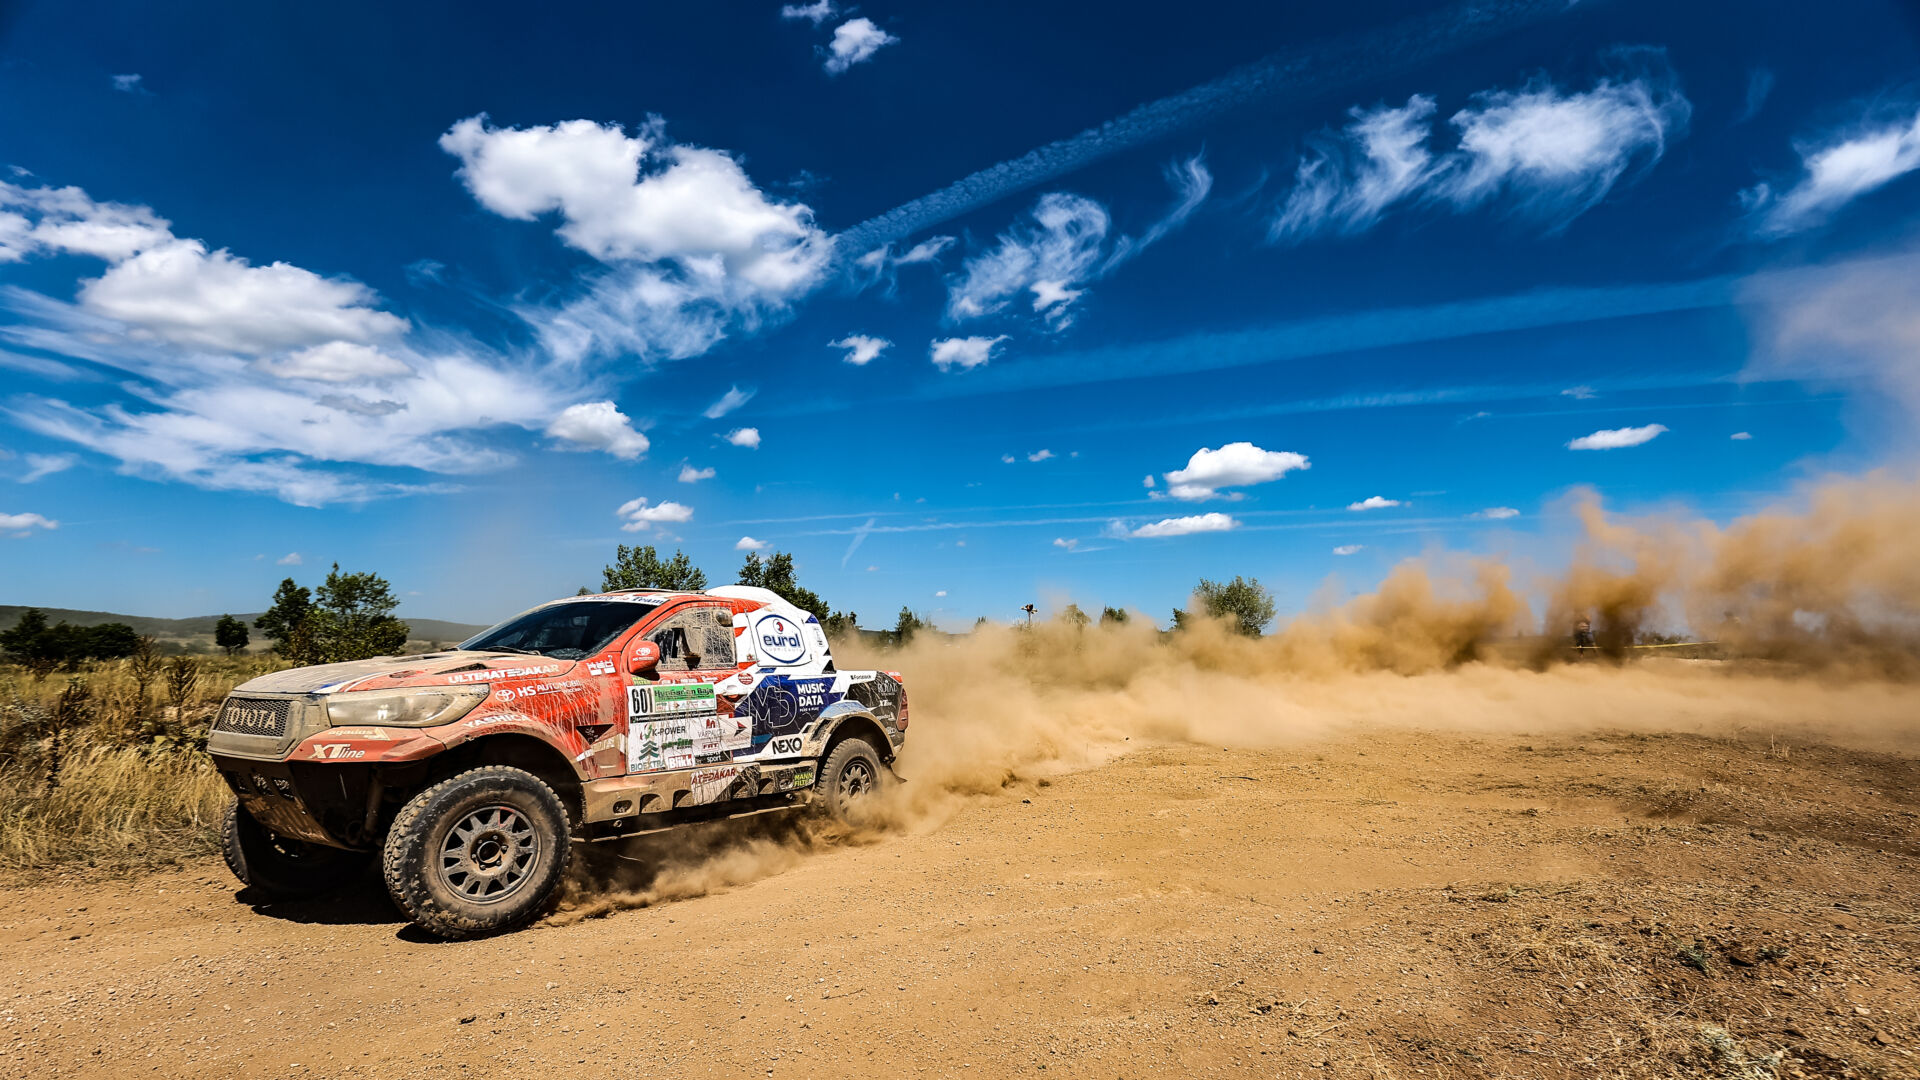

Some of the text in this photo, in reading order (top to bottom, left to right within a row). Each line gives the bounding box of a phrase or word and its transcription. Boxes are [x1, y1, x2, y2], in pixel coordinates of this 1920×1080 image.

[763, 634, 801, 647] eurol
[517, 684, 538, 698] HS
[697, 687, 714, 695] Baja
[796, 683, 826, 695] MUSIC
[631, 688, 654, 714] 601
[799, 695, 824, 707] DATA
[224, 706, 277, 730] TOYOTA
[463, 714, 531, 728] YASHICA
[652, 726, 687, 737] K-POWER
[307, 743, 366, 760] XTline
[772, 737, 803, 755] NEXO
[706, 755, 722, 764] sport
[795, 772, 813, 781] MANN
